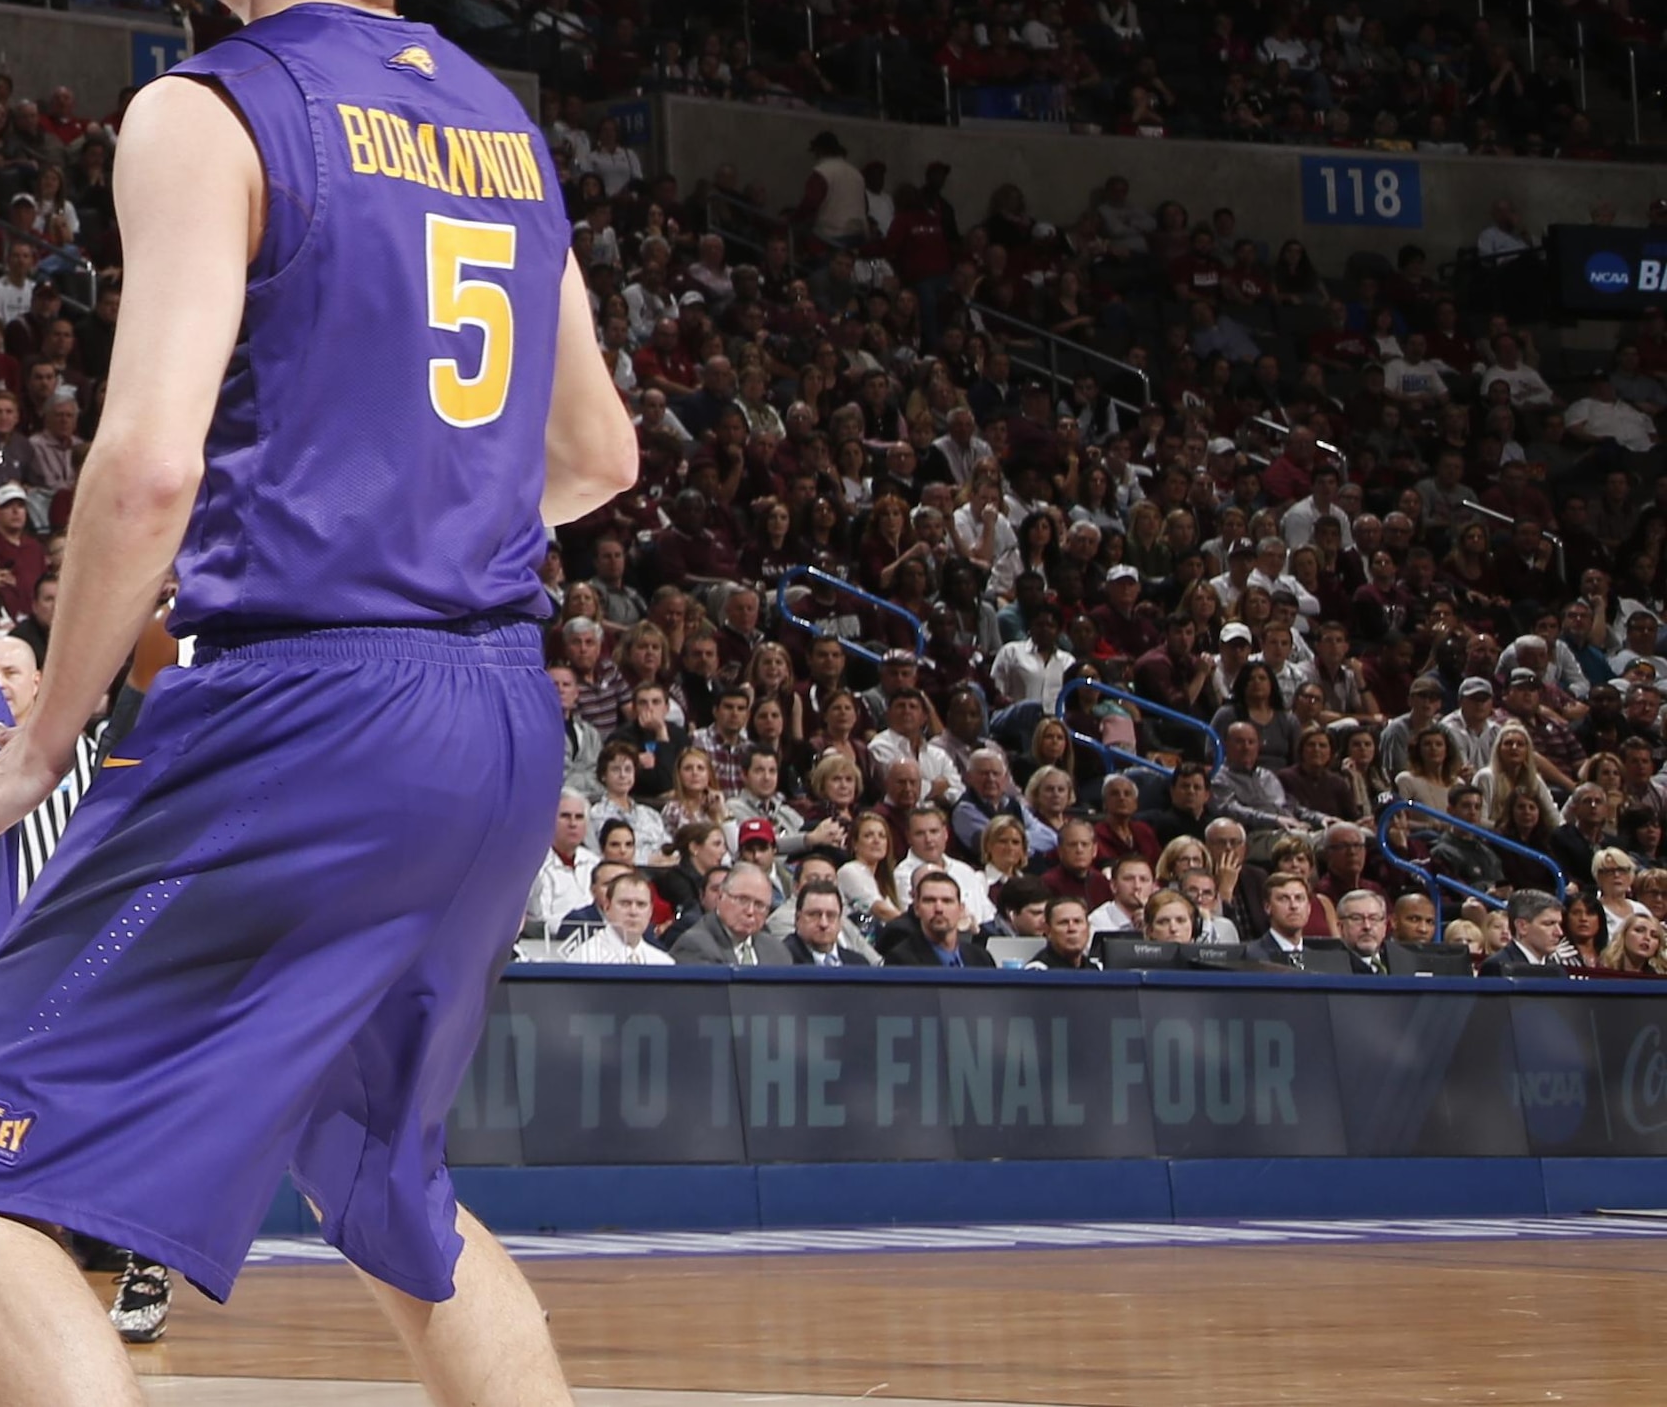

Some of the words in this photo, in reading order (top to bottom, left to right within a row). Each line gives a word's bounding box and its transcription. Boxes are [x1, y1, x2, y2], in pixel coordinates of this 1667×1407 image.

[337, 102, 544, 202] BOHANNON
[1319, 166, 1403, 219] 118
[424, 212, 518, 430] 5
[1589, 271, 1630, 285] NCAA
[569, 1013, 668, 1129] TO
[697, 1014, 846, 1129] THE
[875, 1015, 1086, 1128] FINAL
[1110, 1017, 1299, 1126] FOUR
